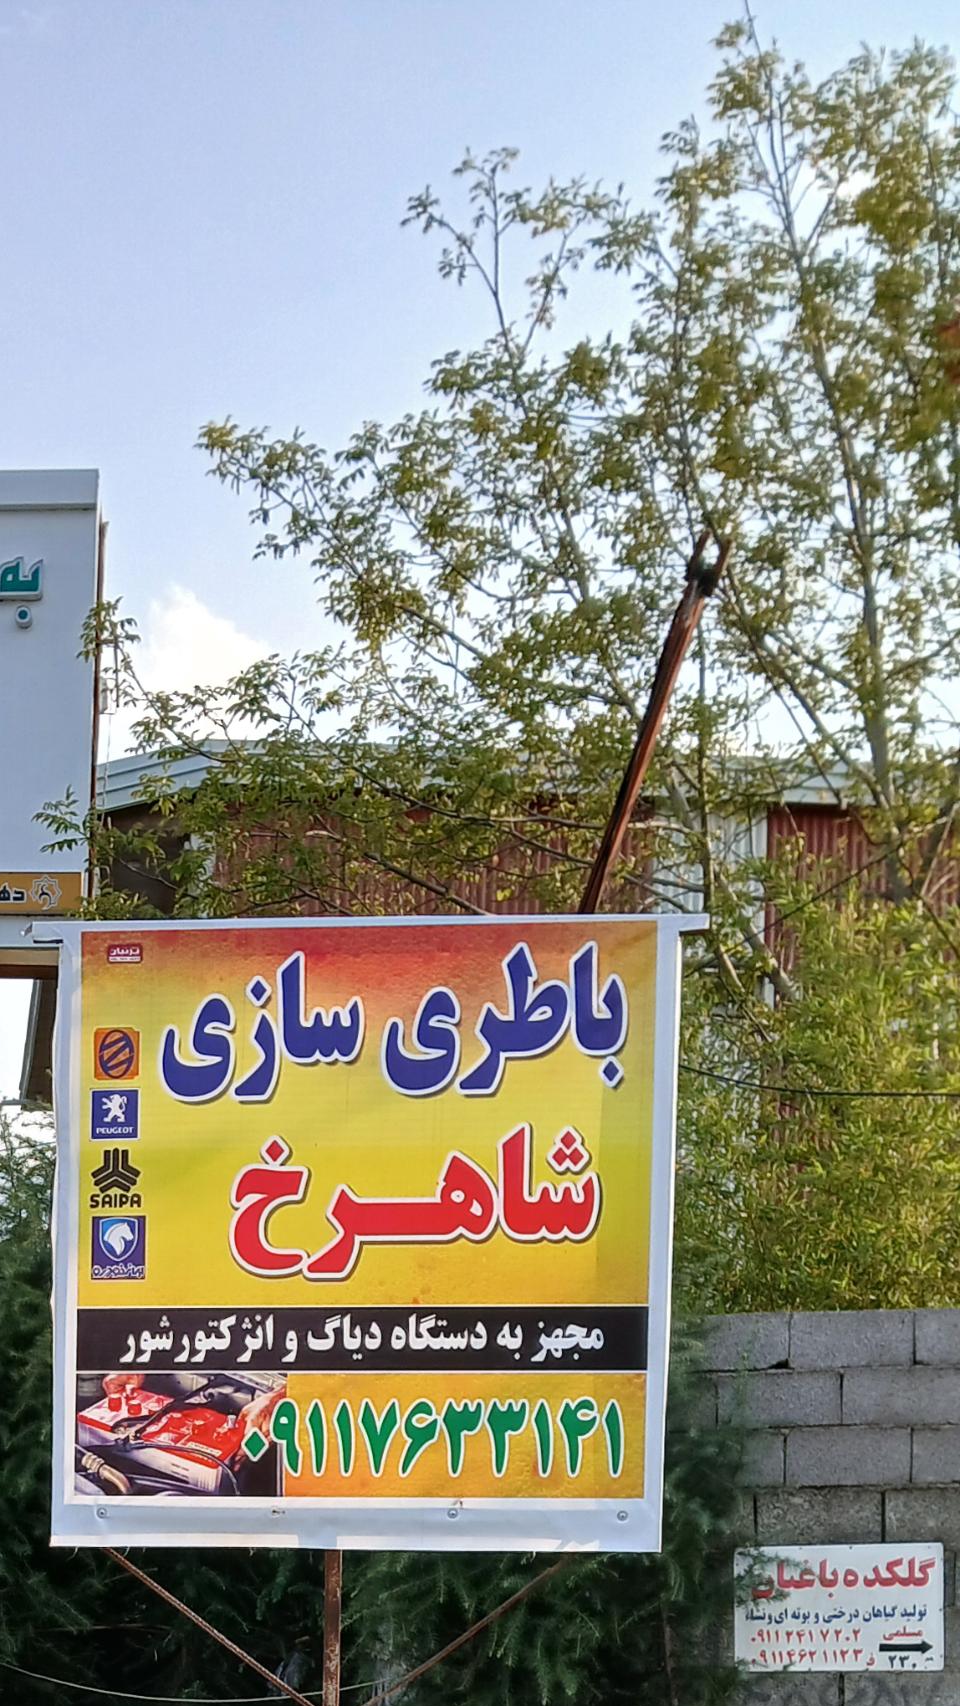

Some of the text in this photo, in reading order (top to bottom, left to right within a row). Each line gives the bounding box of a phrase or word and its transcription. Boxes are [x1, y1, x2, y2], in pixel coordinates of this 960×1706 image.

[158, 940, 628, 1102] باطری سازی
[95, 1126, 135, 1135] PEUGEOT
[89, 1193, 142, 1209] SAIPA
[228, 1121, 603, 1279] شاهرخ
[281, 1329, 298, 1363] و
[307, 1313, 382, 1360] دیاگ
[390, 1314, 489, 1352] دستگاه
[496, 1320, 524, 1365] به
[530, 1319, 606, 1364] مجهز
[241, 1396, 627, 1479] ۰۹۱۱۷۶۳۳۱۴۱
[843, 1555, 936, 1590] گلکده
[774, 1607, 788, 1625] ای
[791, 1607, 810, 1624] بوته
[814, 1612, 820, 1625] و
[823, 1605, 859, 1624] درختی
[900, 1604, 928, 1622] تولید
